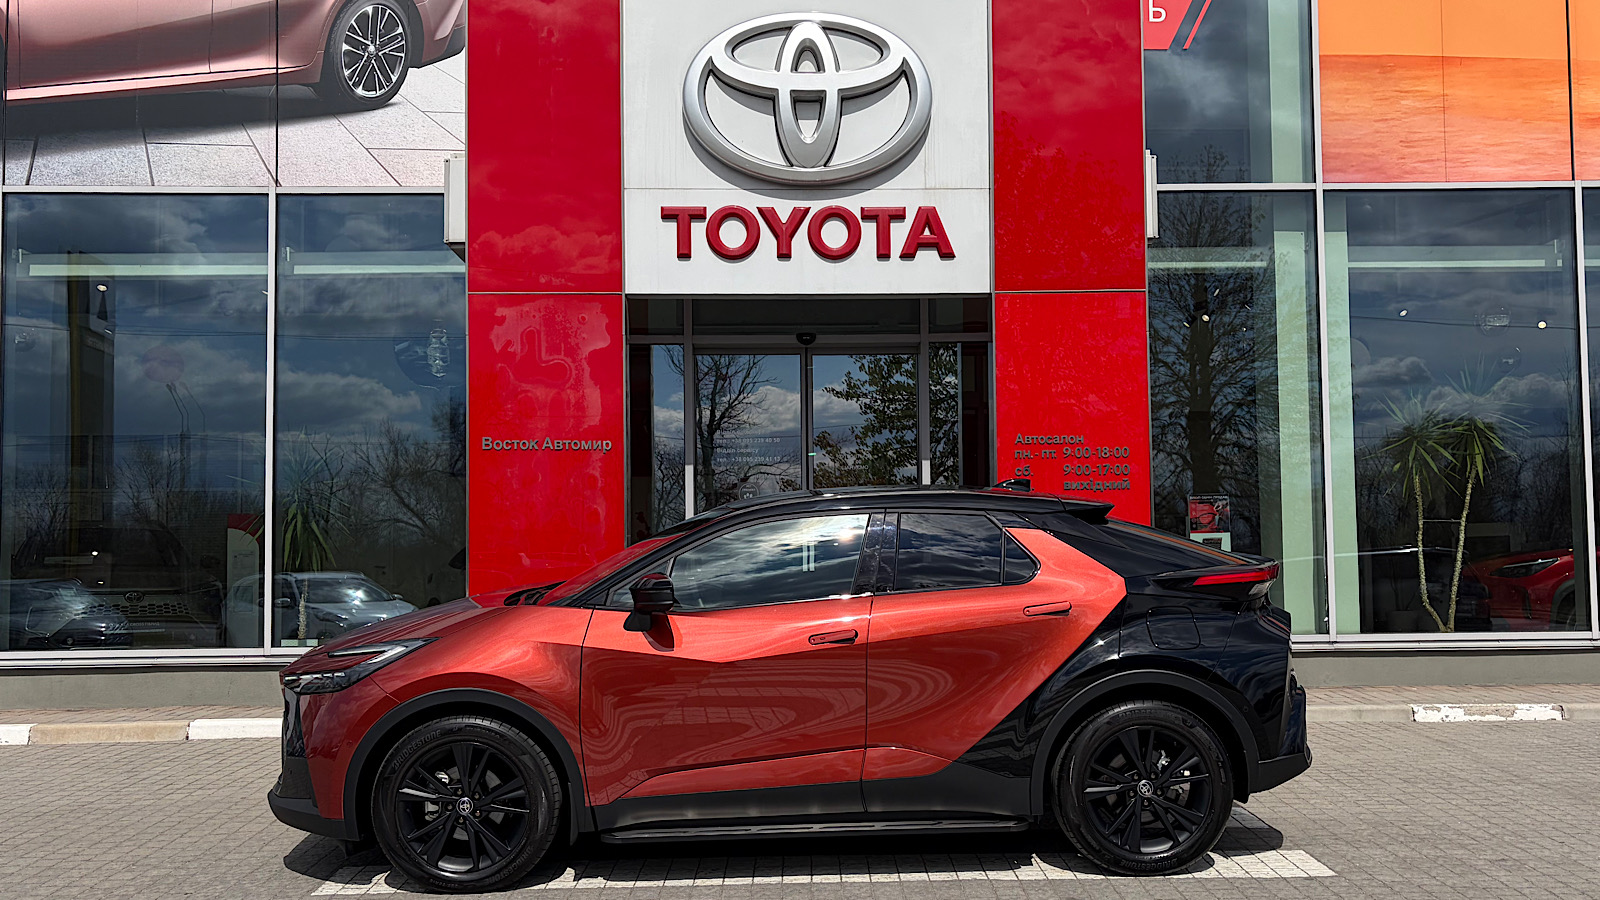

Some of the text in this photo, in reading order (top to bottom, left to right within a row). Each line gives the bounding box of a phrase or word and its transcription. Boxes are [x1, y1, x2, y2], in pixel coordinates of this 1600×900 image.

[660, 204, 957, 262] TOYOTA
[481, 436, 613, 455] Восток Автомир
[1014, 433, 1085, 446] Автосалон
[1063, 446, 1130, 459] 9:00-18:00
[1014, 464, 1131, 477] сб. 9:00-17:00
[1063, 478, 1131, 493] вихідний
[391, 729, 442, 771] BRIDGESTONE
